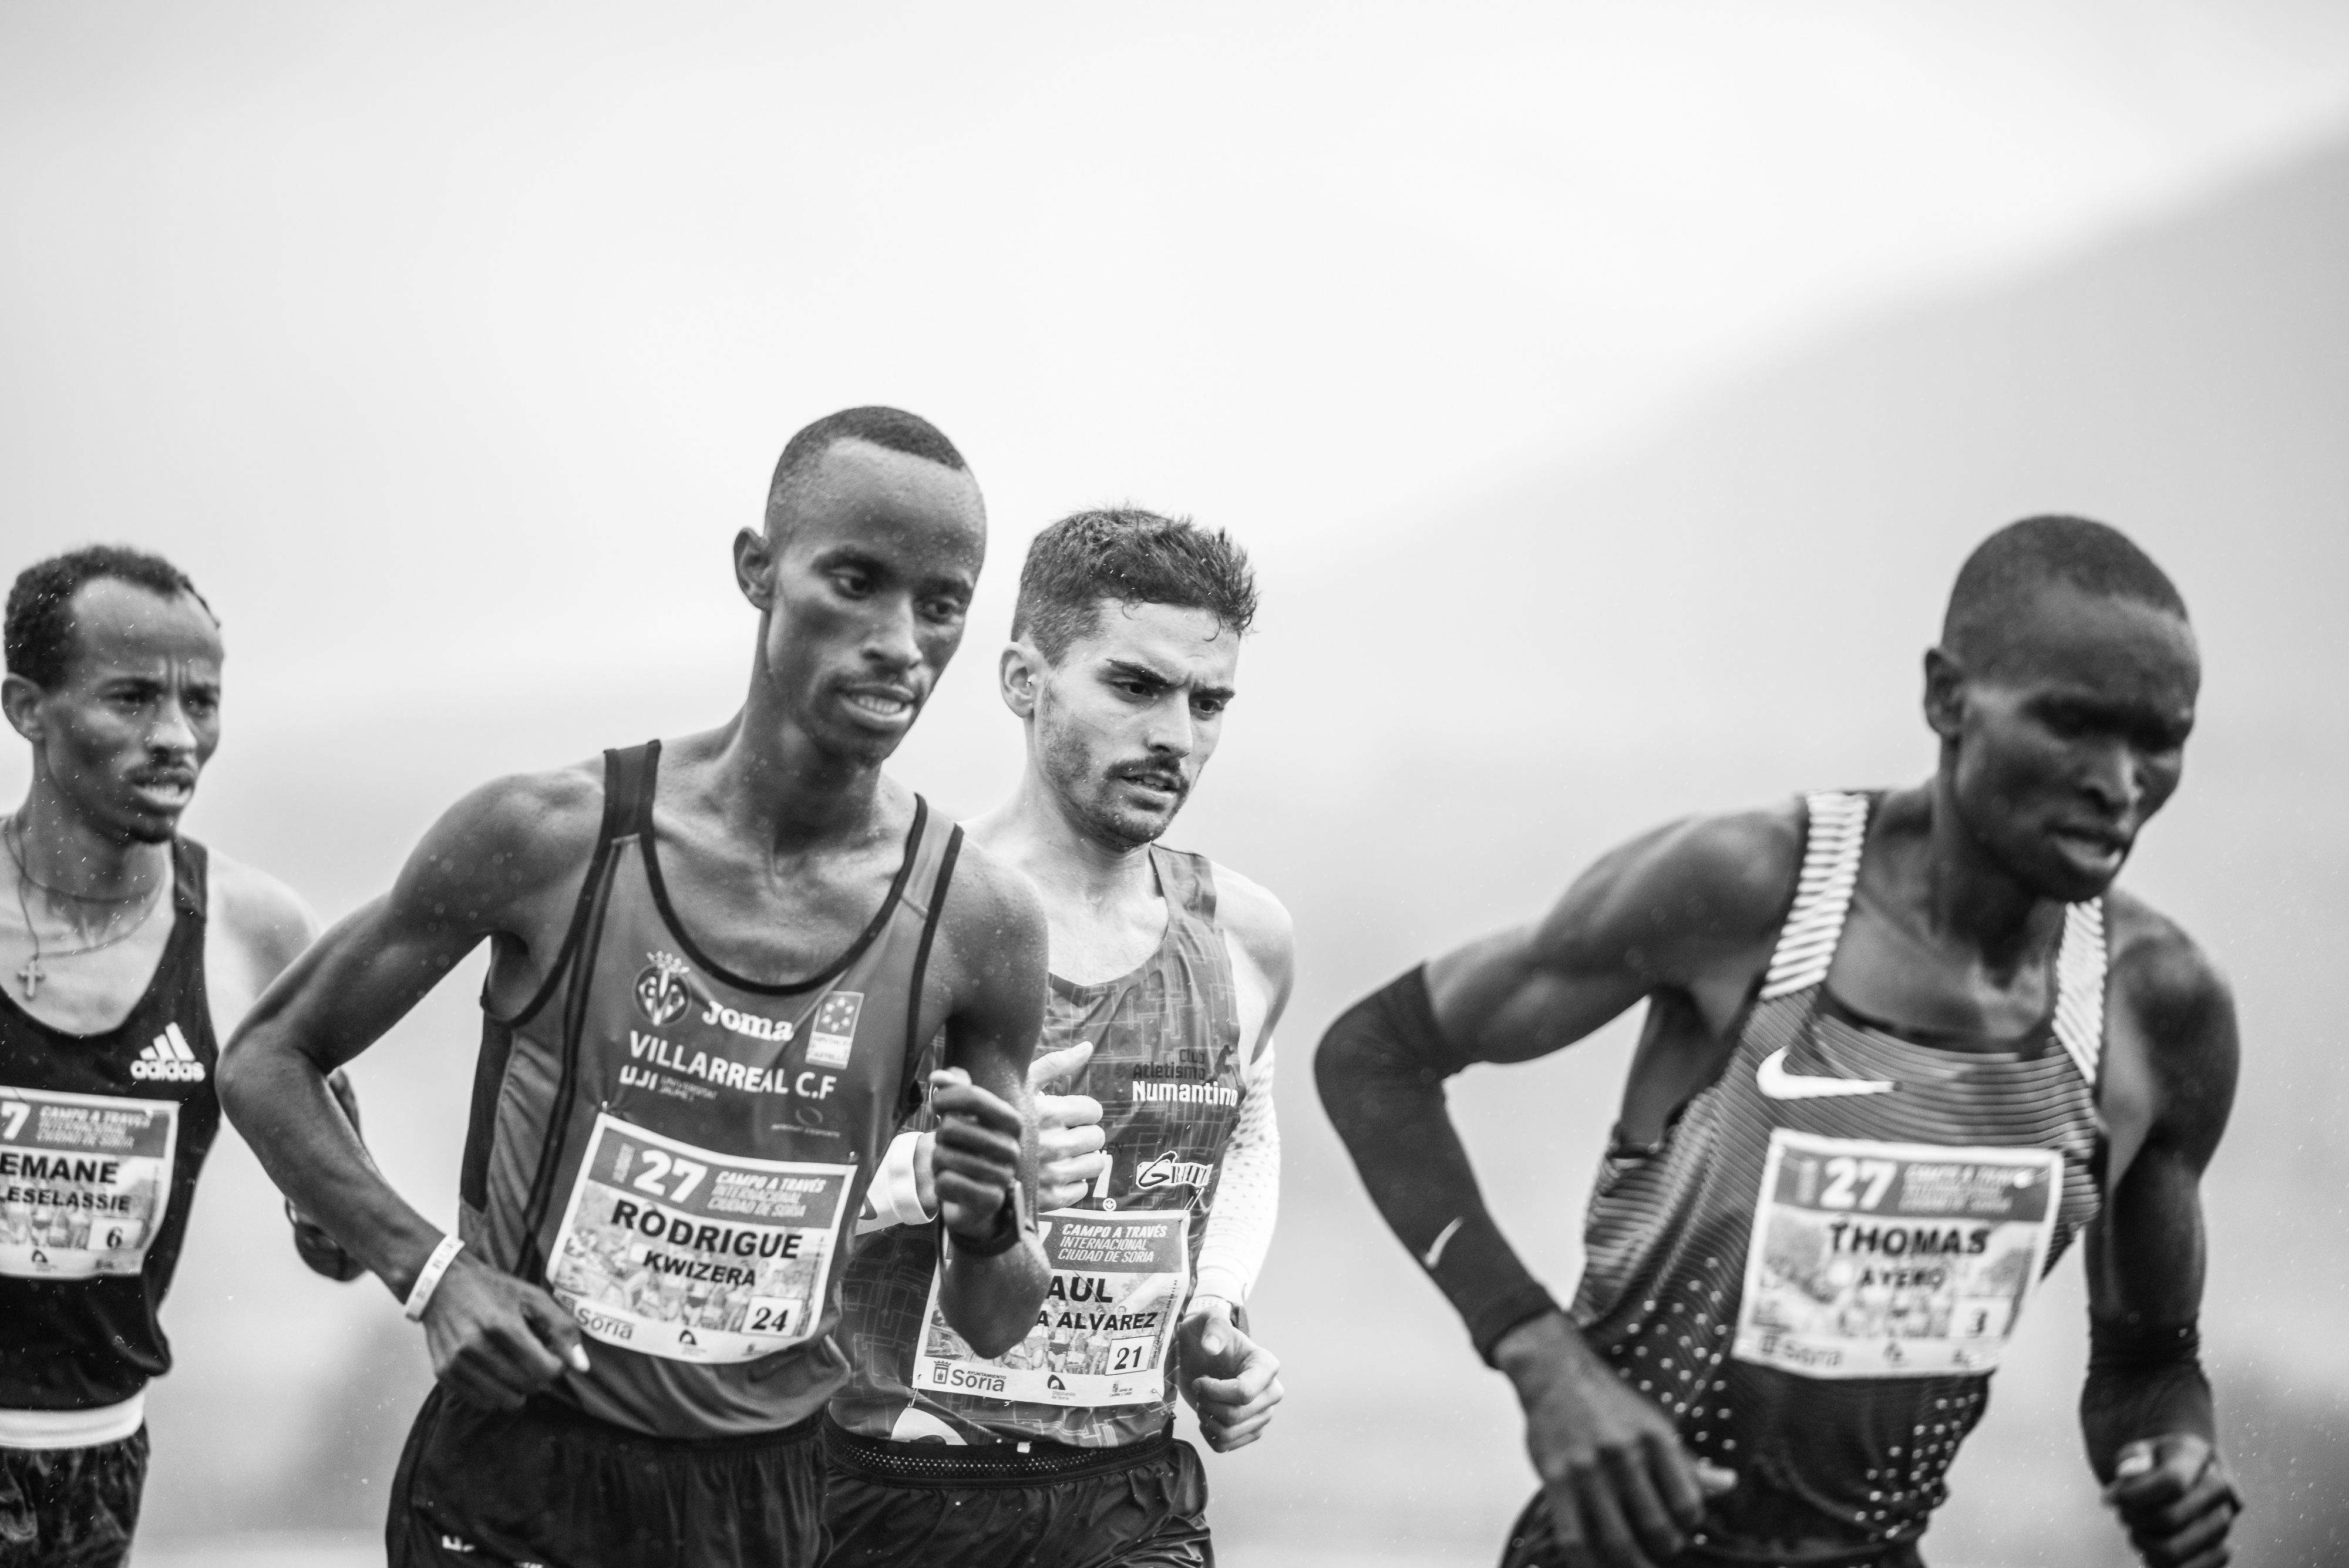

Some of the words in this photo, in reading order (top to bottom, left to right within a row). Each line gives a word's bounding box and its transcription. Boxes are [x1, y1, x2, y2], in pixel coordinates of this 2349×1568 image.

[702, 1001, 794, 1041] Joma
[130, 1059, 206, 1082] adidas
[630, 1031, 788, 1093] VILLARREAL
[1132, 1061, 1205, 1081] Atletismo
[620, 1064, 658, 1091] UJI
[1132, 1080, 1239, 1106] Numantino
[0, 1152, 119, 1184] EMANE
[633, 1149, 708, 1203] 27
[1820, 1158, 1897, 1210] 27
[0, 1185, 131, 1212] ESELASSIE
[106, 1226, 123, 1249] 6
[611, 1199, 803, 1260] RODRIGUE
[1061, 1223, 1112, 1238] CAMPO
[1112, 1226, 1123, 1239] A
[1125, 1223, 1168, 1238] TRAVÉS
[1828, 1222, 1991, 1256] THOMAS
[1058, 1248, 1104, 1262] CIUDAD
[1103, 1250, 1122, 1263] DE
[1121, 1251, 1155, 1263] SORIA
[1059, 1236, 1147, 1251] INTERNACIONAL
[642, 1250, 756, 1287] KWIZERA
[751, 1307, 789, 1333] 24
[1057, 1311, 1158, 1331] ALVAREZ
[1113, 1346, 1142, 1371] 21
[950, 1368, 1005, 1392] Soria
[968, 1370, 1007, 1380] AYUNTAMIENTO
